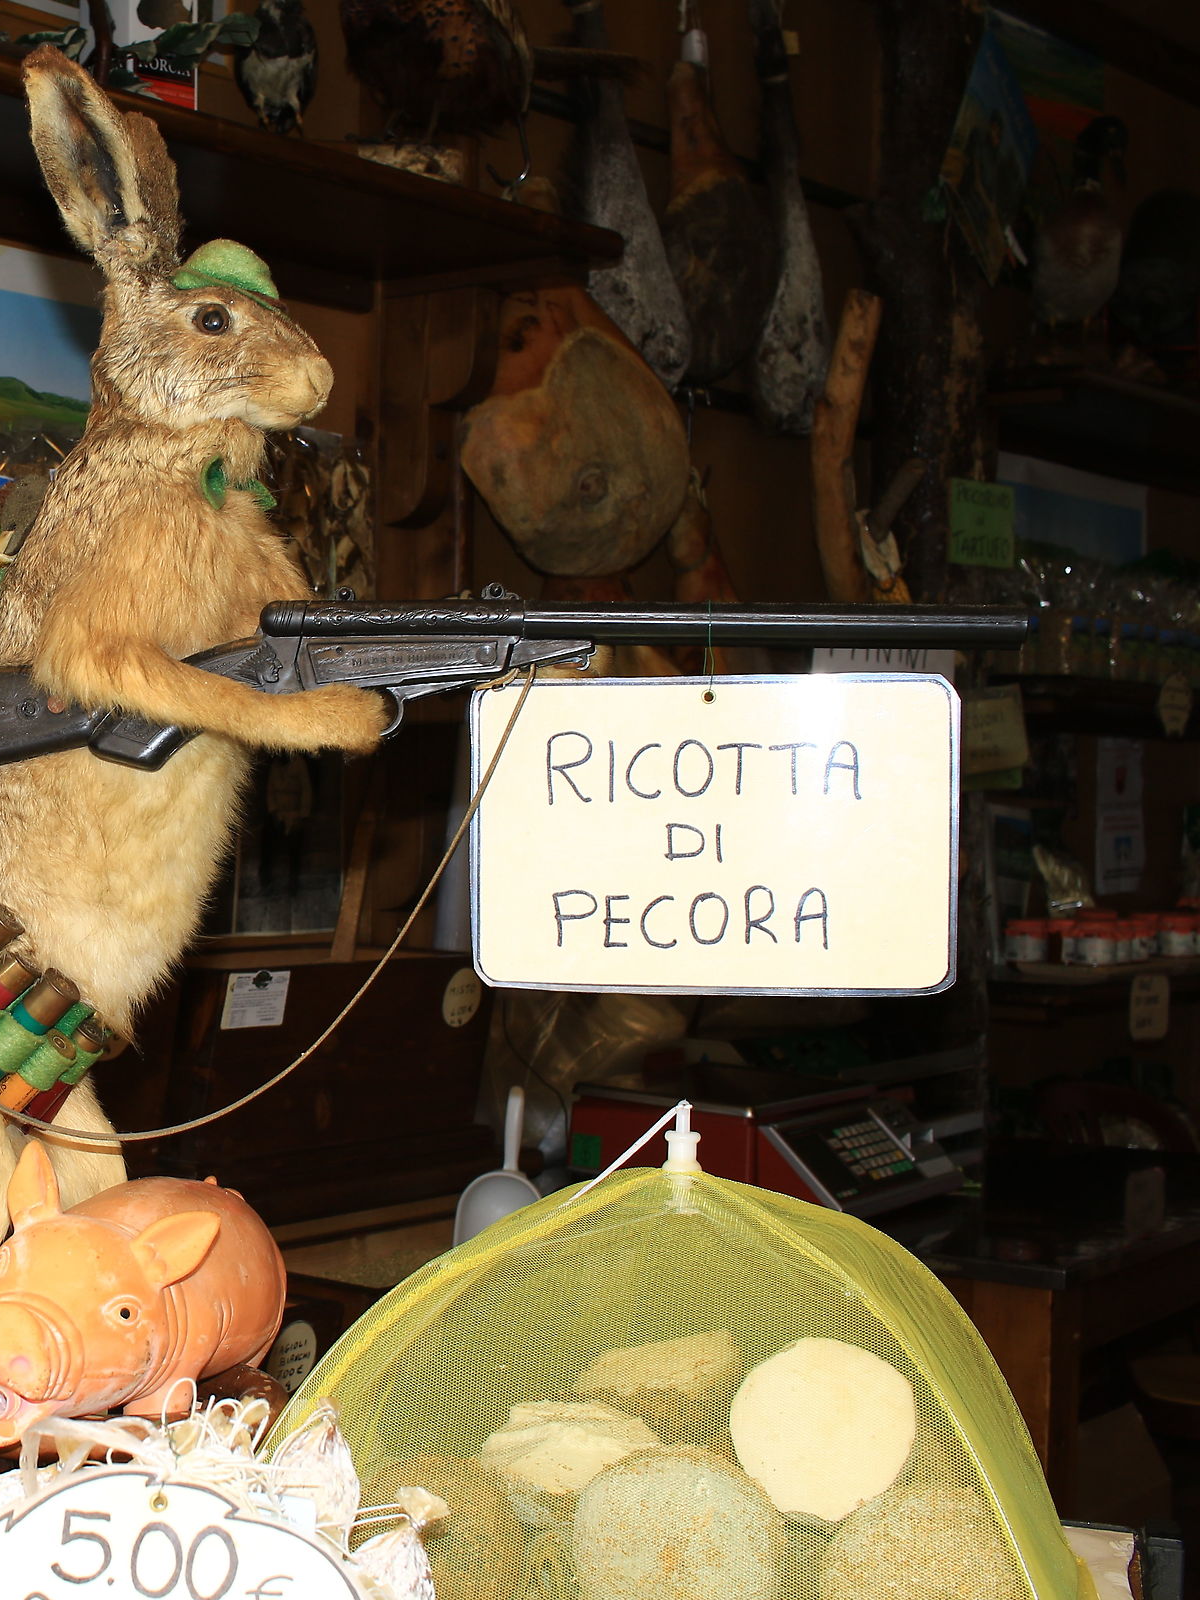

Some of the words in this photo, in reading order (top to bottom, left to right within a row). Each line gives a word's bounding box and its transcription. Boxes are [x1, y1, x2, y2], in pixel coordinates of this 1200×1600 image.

[545, 730, 862, 806] RICOTTA
[664, 823, 723, 863] DI
[552, 885, 829, 950] PECORA
[51, 1508, 239, 1600] 5.00
